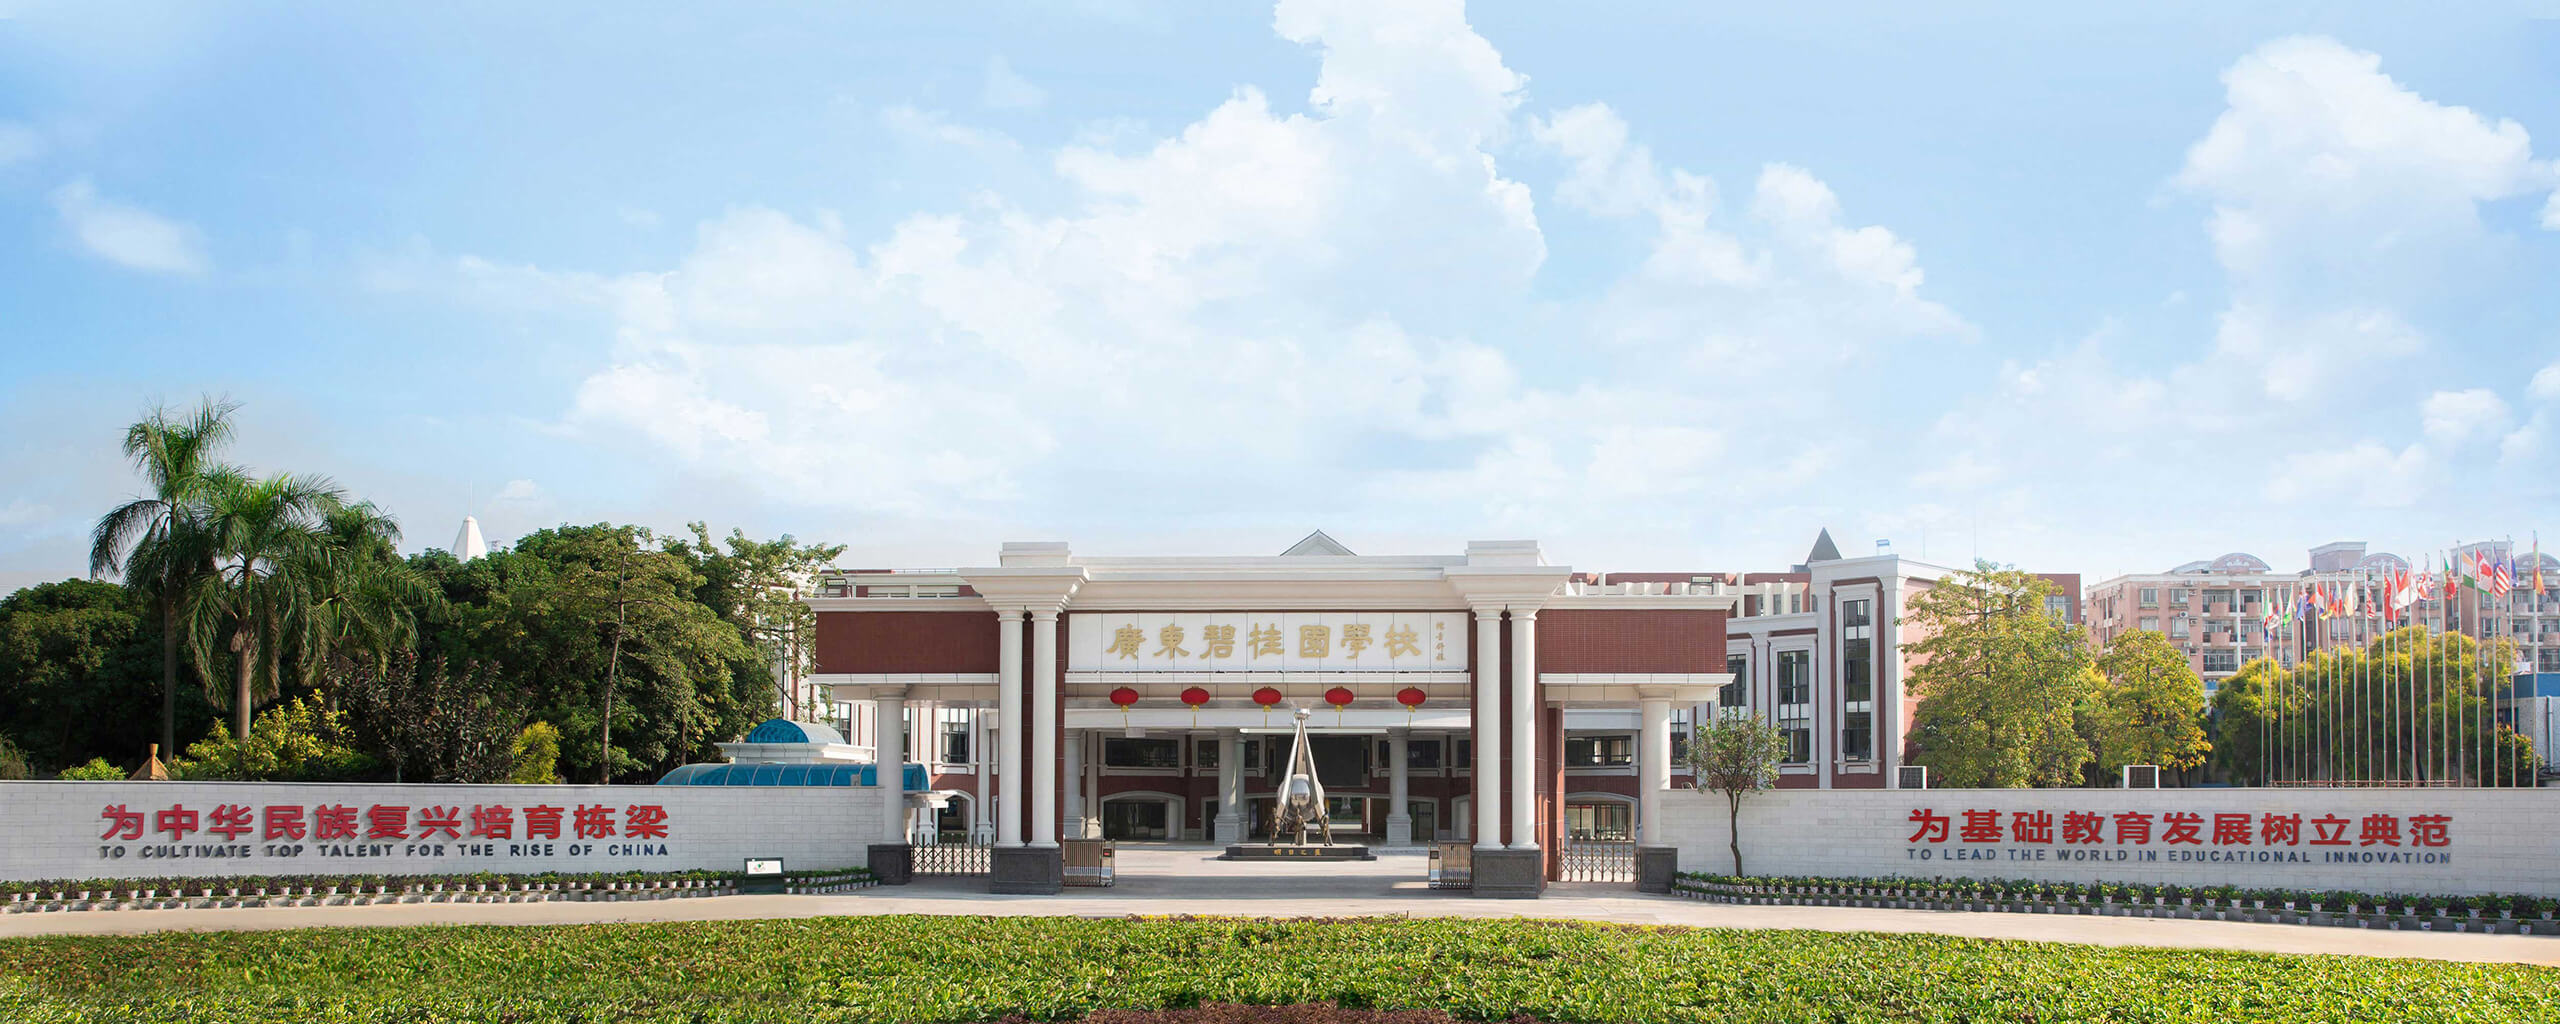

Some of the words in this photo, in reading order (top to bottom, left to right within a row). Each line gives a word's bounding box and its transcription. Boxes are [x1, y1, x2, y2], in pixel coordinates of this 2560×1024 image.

[1105, 622, 1422, 661] 廣東碧桂園學校
[101, 803, 670, 842] 为中华民族复兴培育栋梁
[1907, 808, 2453, 848] 为基础教育发展树立典范
[101, 845, 127, 859] TO
[143, 845, 252, 859] CULTIVATE
[266, 845, 304, 858] TOP
[318, 844, 395, 858] TALENT
[406, 844, 446, 858] FOR
[457, 844, 494, 857] THE
[510, 844, 554, 857] RISE
[568, 844, 594, 857] OF
[607, 844, 670, 857] CHINA
[1907, 848, 1932, 861] TO
[1943, 848, 1997, 861] LEAD
[2008, 848, 2046, 861] THE
[2057, 849, 2129, 862] WORLD
[2138, 849, 2158, 862] IN
[2168, 850, 2312, 863] EDUCATIONAL
[2325, 851, 2453, 865] INNOVATION
